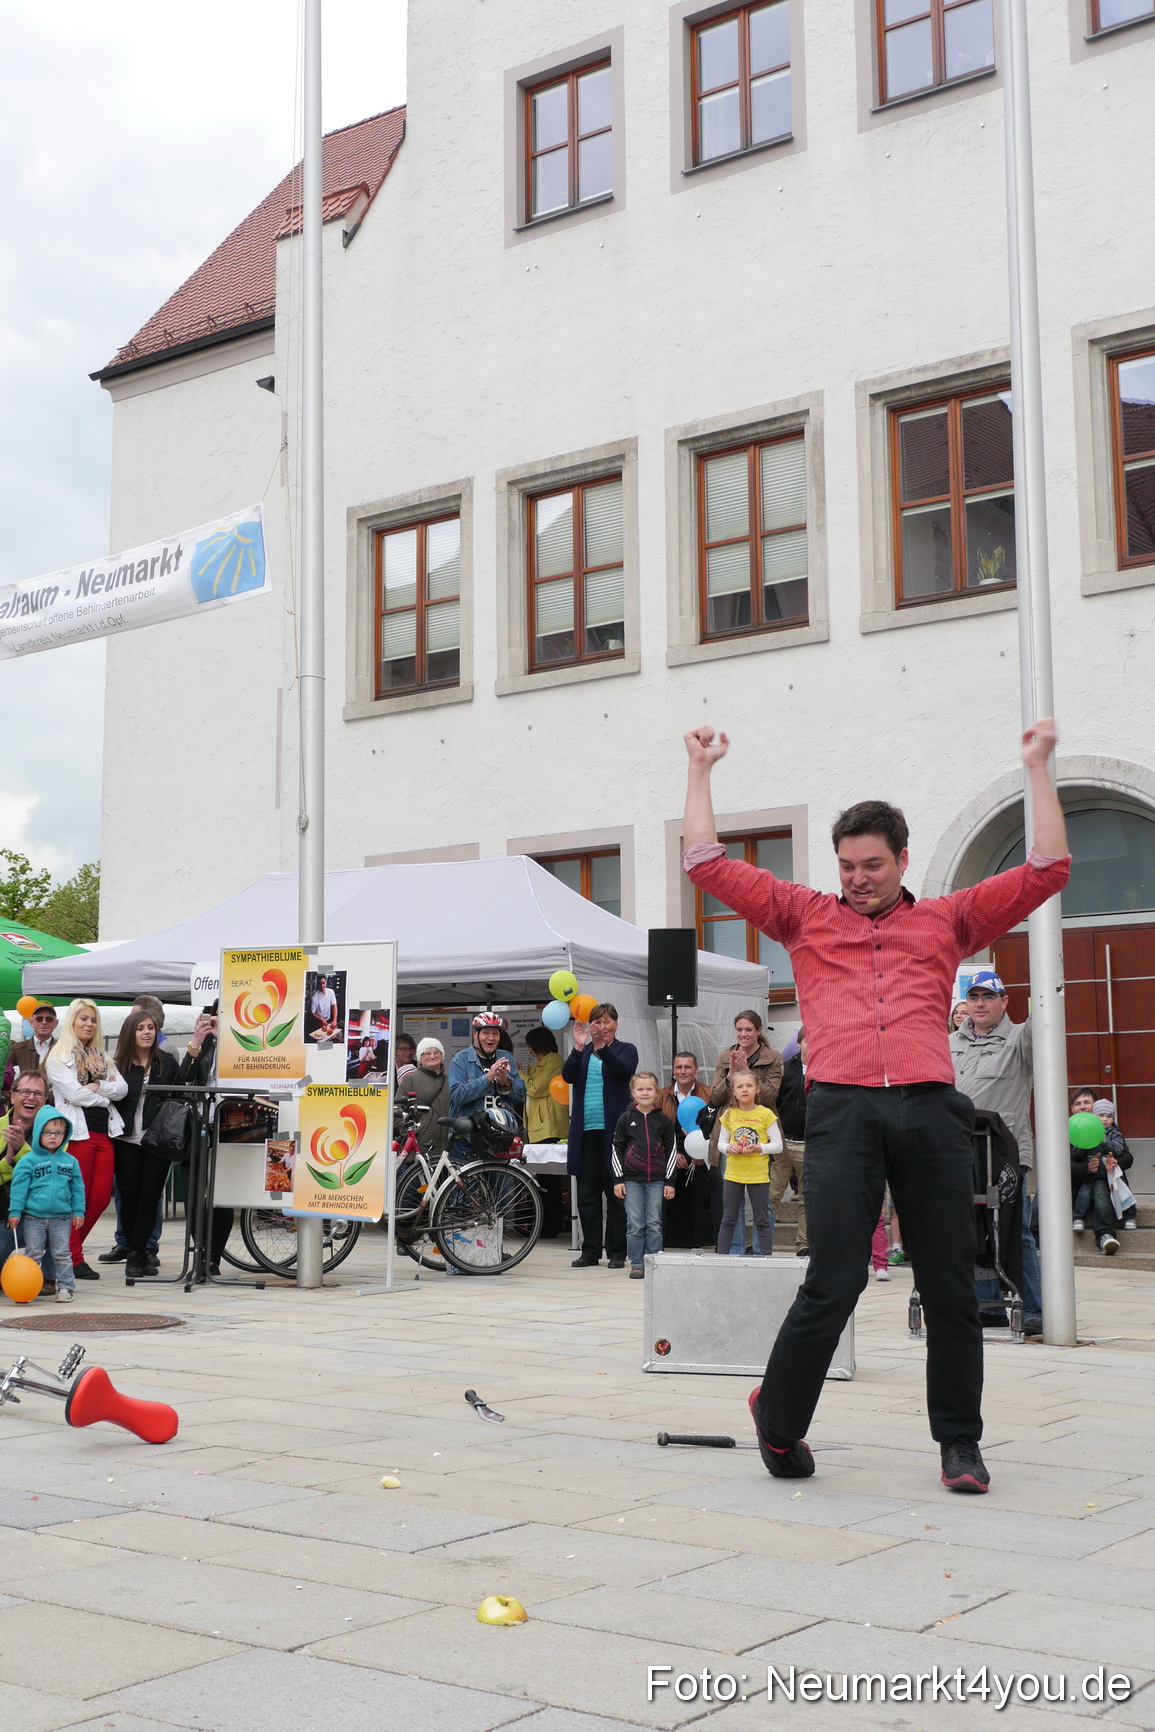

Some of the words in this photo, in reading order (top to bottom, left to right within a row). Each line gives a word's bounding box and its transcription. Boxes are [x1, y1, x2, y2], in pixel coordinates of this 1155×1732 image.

[75, 542, 183, 600] Neumarkt
[0, 617, 47, 640] emeinschaft
[48, 611, 75, 625] offene
[76, 587, 156, 618] Behindertenarbeit
[12, 635, 53, 653] Landkreis
[50, 623, 96, 642] Neumarkt
[230, 952, 302, 963] SYMPATHIEBLUME
[193, 976, 219, 991] Offen
[230, 979, 254, 988] BEIRAT
[237, 1055, 250, 1063] FÜR
[251, 1055, 286, 1063] MENSCHEN
[307, 1086, 382, 1097] SYMPATHIEBLUME
[34, 1165, 52, 1179] STC
[314, 1192, 327, 1201] FÜR
[327, 1194, 364, 1202] MENSCHEN
[321, 1201, 368, 1210] BEHINDERUNG
